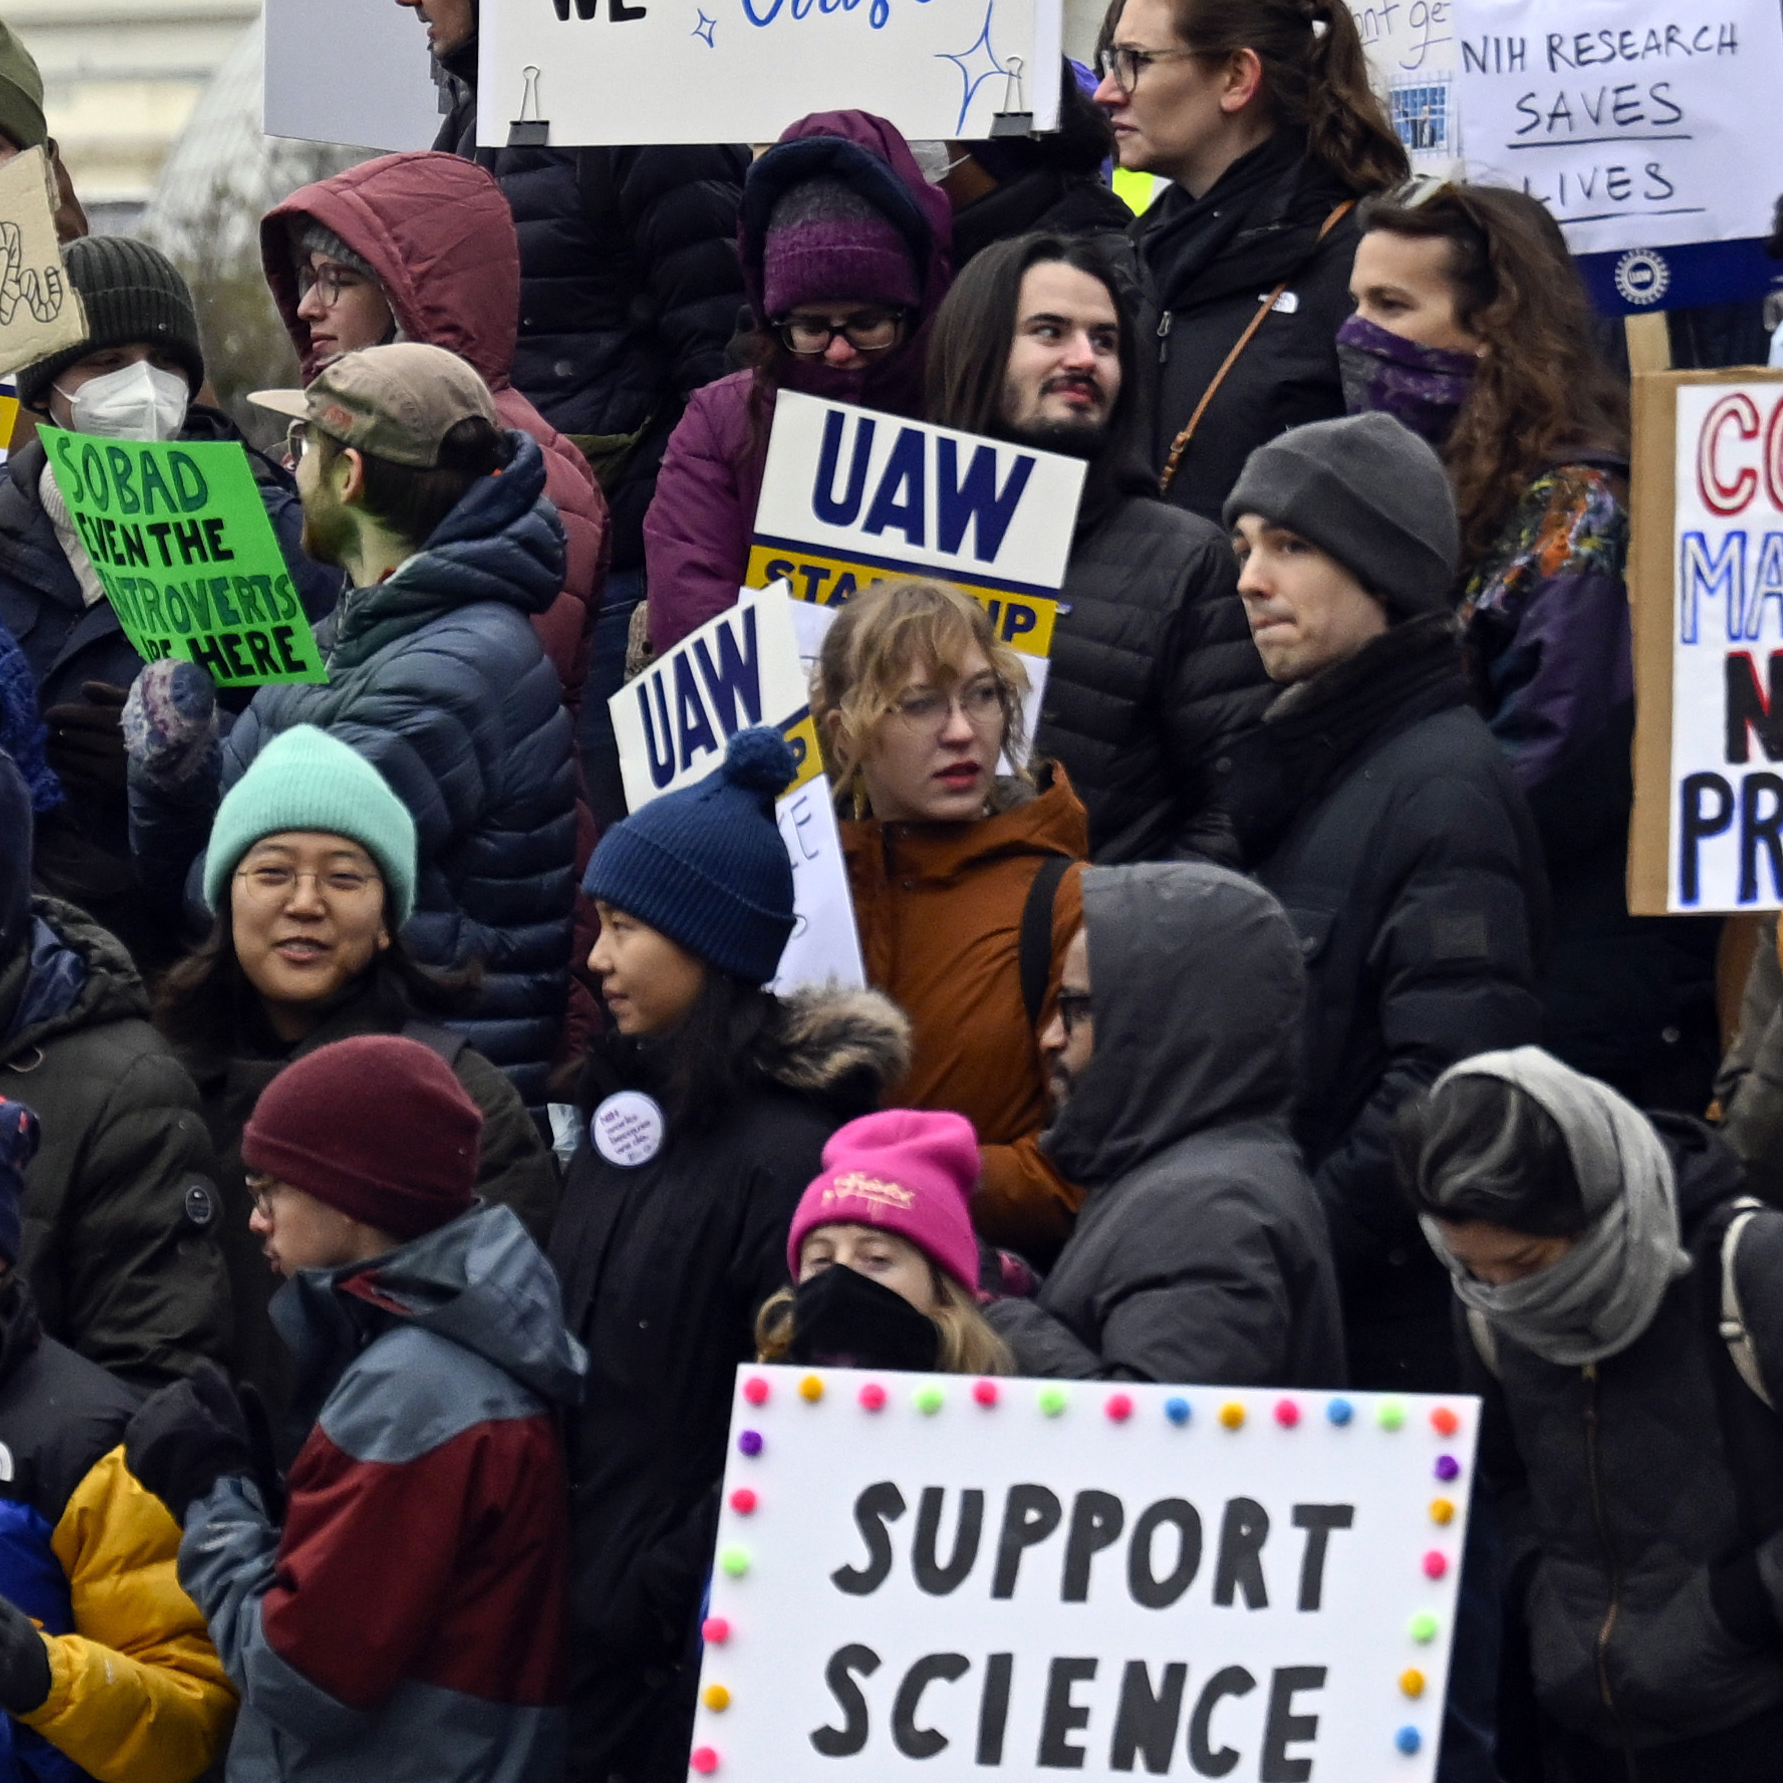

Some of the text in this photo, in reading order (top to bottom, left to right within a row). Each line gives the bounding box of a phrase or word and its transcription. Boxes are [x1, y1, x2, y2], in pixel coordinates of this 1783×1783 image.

[1461, 22, 1739, 75] NIH RESEARCH
[1515, 83, 1686, 136] SAVES
[1522, 162, 1676, 208] LIVES
[811, 409, 1036, 564] UAW
[147, 518, 235, 567] THE
[186, 626, 308, 680] HERE
[636, 605, 763, 790] UAW
[829, 1480, 1355, 1612] SUPPORT
[808, 1642, 1328, 1783] SCIENCE
